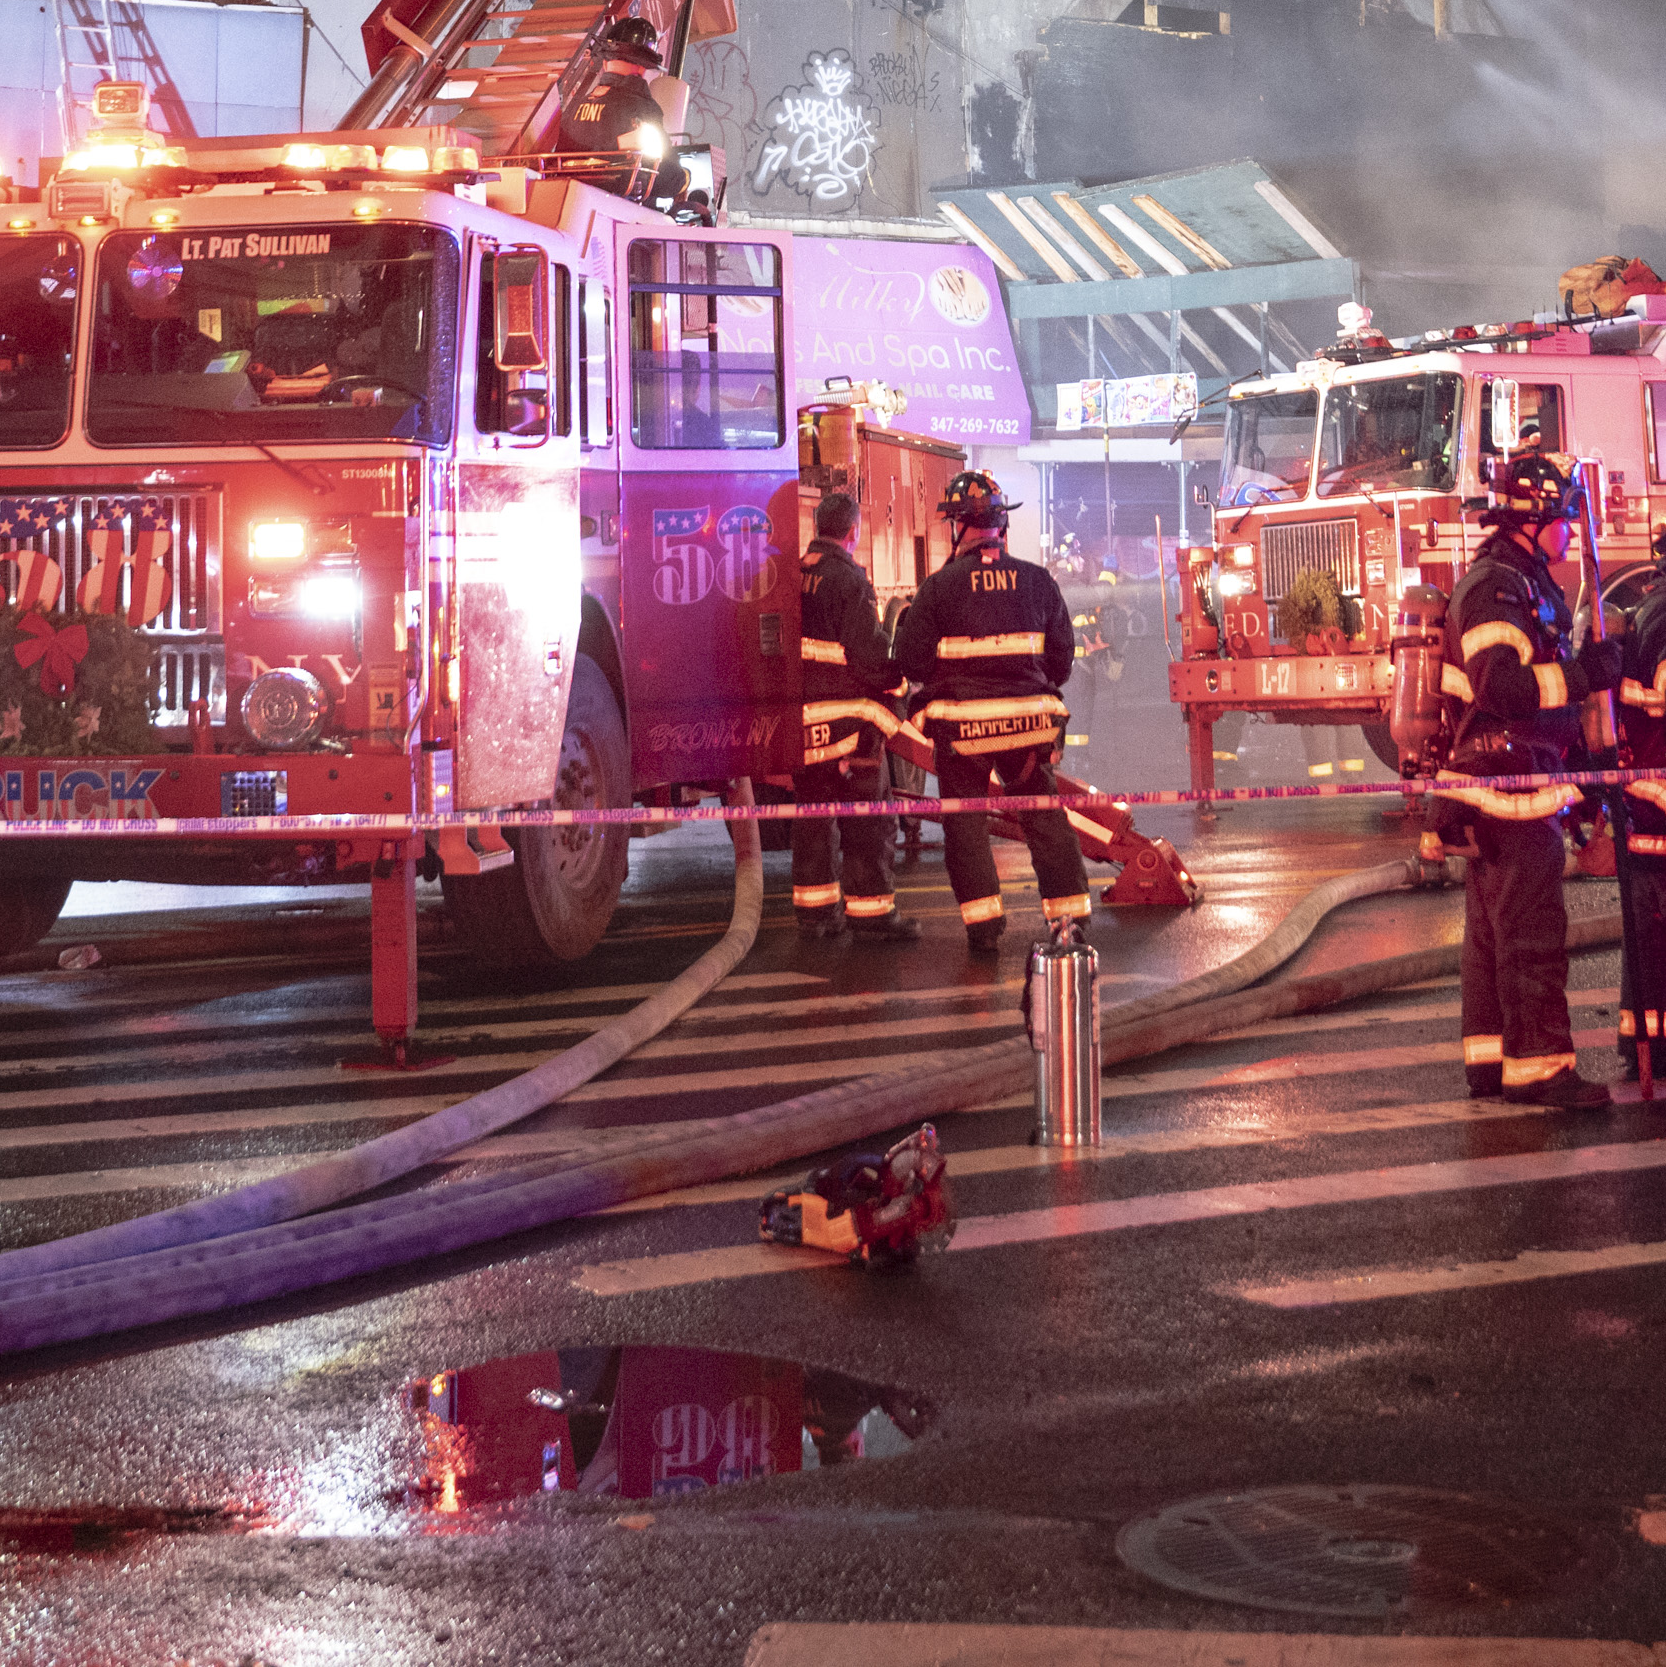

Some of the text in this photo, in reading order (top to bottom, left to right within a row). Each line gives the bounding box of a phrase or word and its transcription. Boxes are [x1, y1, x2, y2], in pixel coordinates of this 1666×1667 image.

[574, 103, 606, 122] FDNY
[182, 233, 331, 261] LT. PAT SULLIVAN
[813, 332, 876, 366] And
[886, 335, 949, 379] Spa
[959, 337, 1011, 372] Inc.
[948, 384, 995, 402] CARE
[930, 418, 1019, 435] 347-269-7632
[652, 504, 778, 606] 58
[970, 569, 1019, 593] FDNY
[1261, 662, 1291, 695] L-17
